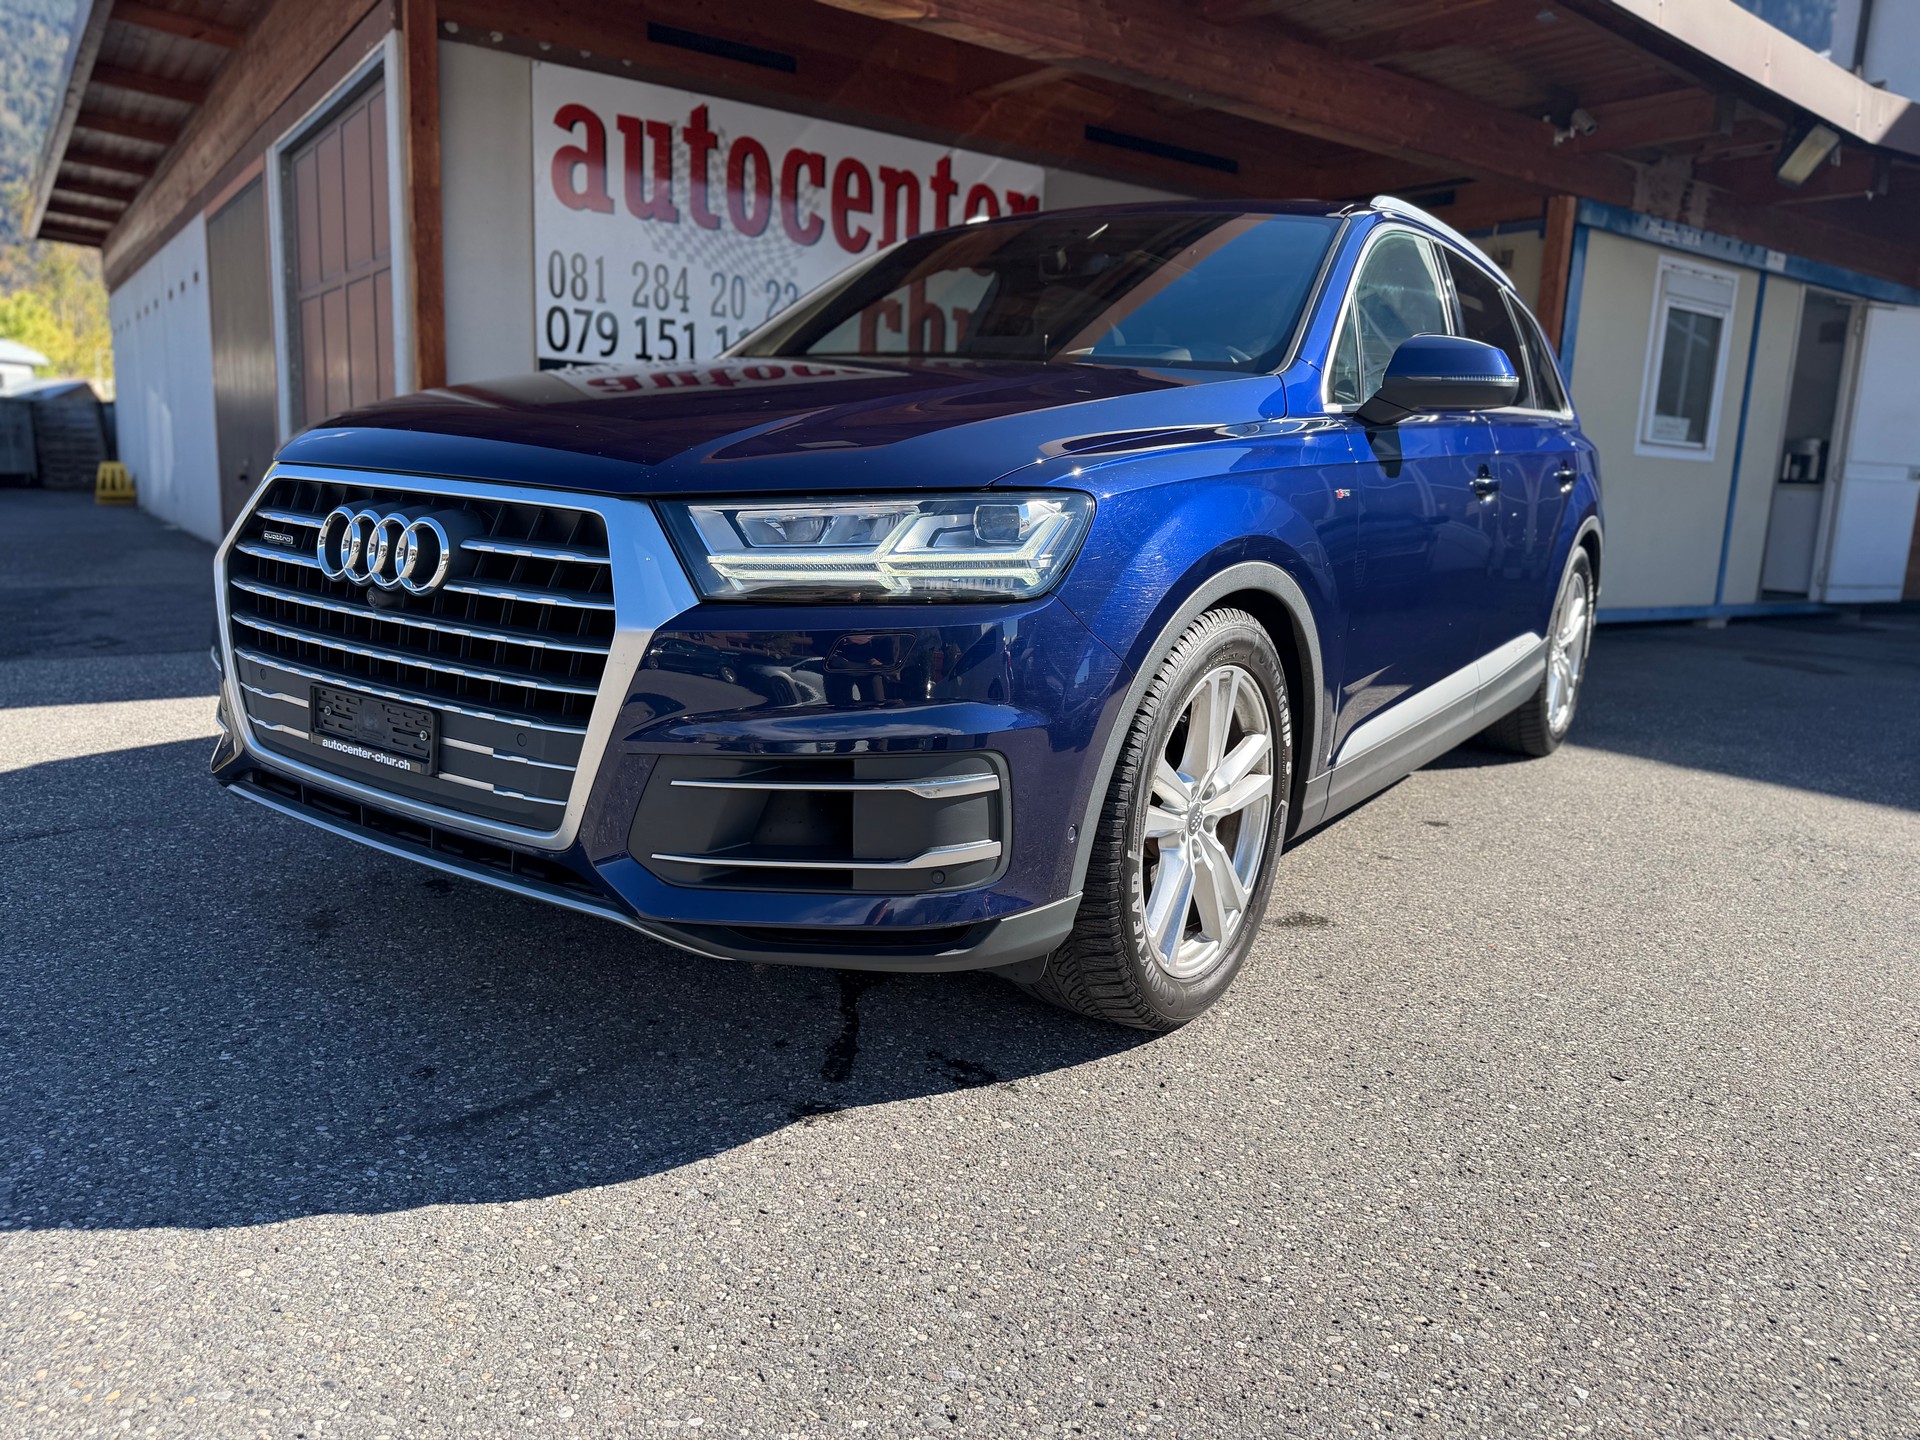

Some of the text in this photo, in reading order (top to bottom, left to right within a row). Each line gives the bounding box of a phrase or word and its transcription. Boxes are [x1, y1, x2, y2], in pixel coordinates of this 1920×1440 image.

[551, 103, 1040, 255] autocent
[547, 249, 607, 304] 081
[631, 260, 691, 313] 284
[711, 271, 746, 320] 20
[546, 305, 750, 361] 079 151 1
[263, 531, 293, 544] quattro
[1258, 651, 1292, 747] ULTRAGRIP
[322, 738, 411, 771] autocenter-chur.ch
[1131, 871, 1177, 1007] GOODYEAR
